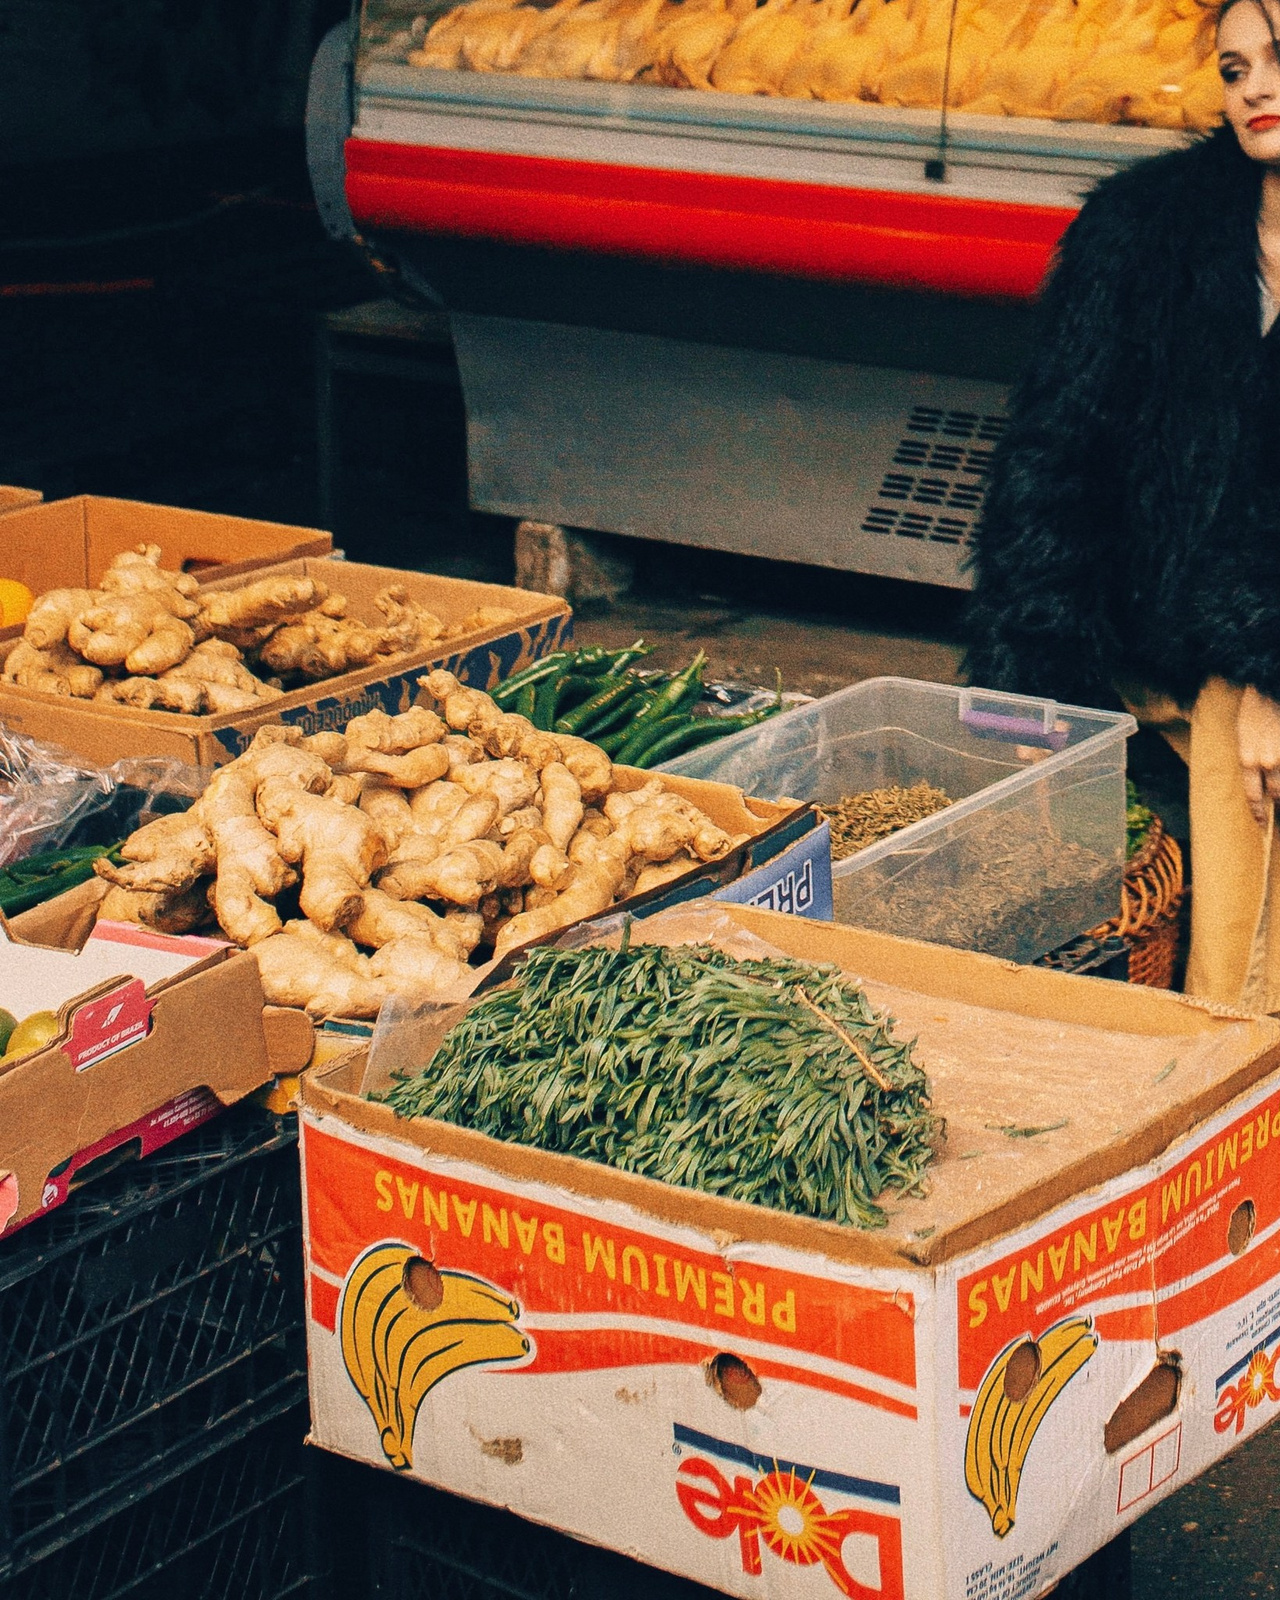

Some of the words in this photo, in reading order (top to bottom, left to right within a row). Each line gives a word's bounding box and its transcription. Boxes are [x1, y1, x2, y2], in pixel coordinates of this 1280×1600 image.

[78, 1037, 111, 1061] PRODUCT
[111, 1032, 121, 1043] OF
[120, 1020, 144, 1039] BRAZIL
[374, 1169, 567, 1260] BANANAS
[967, 1197, 1147, 1329] BANANAS
[581, 1232, 798, 1334] PREMIUM
[675, 1457, 903, 1600] Dole
